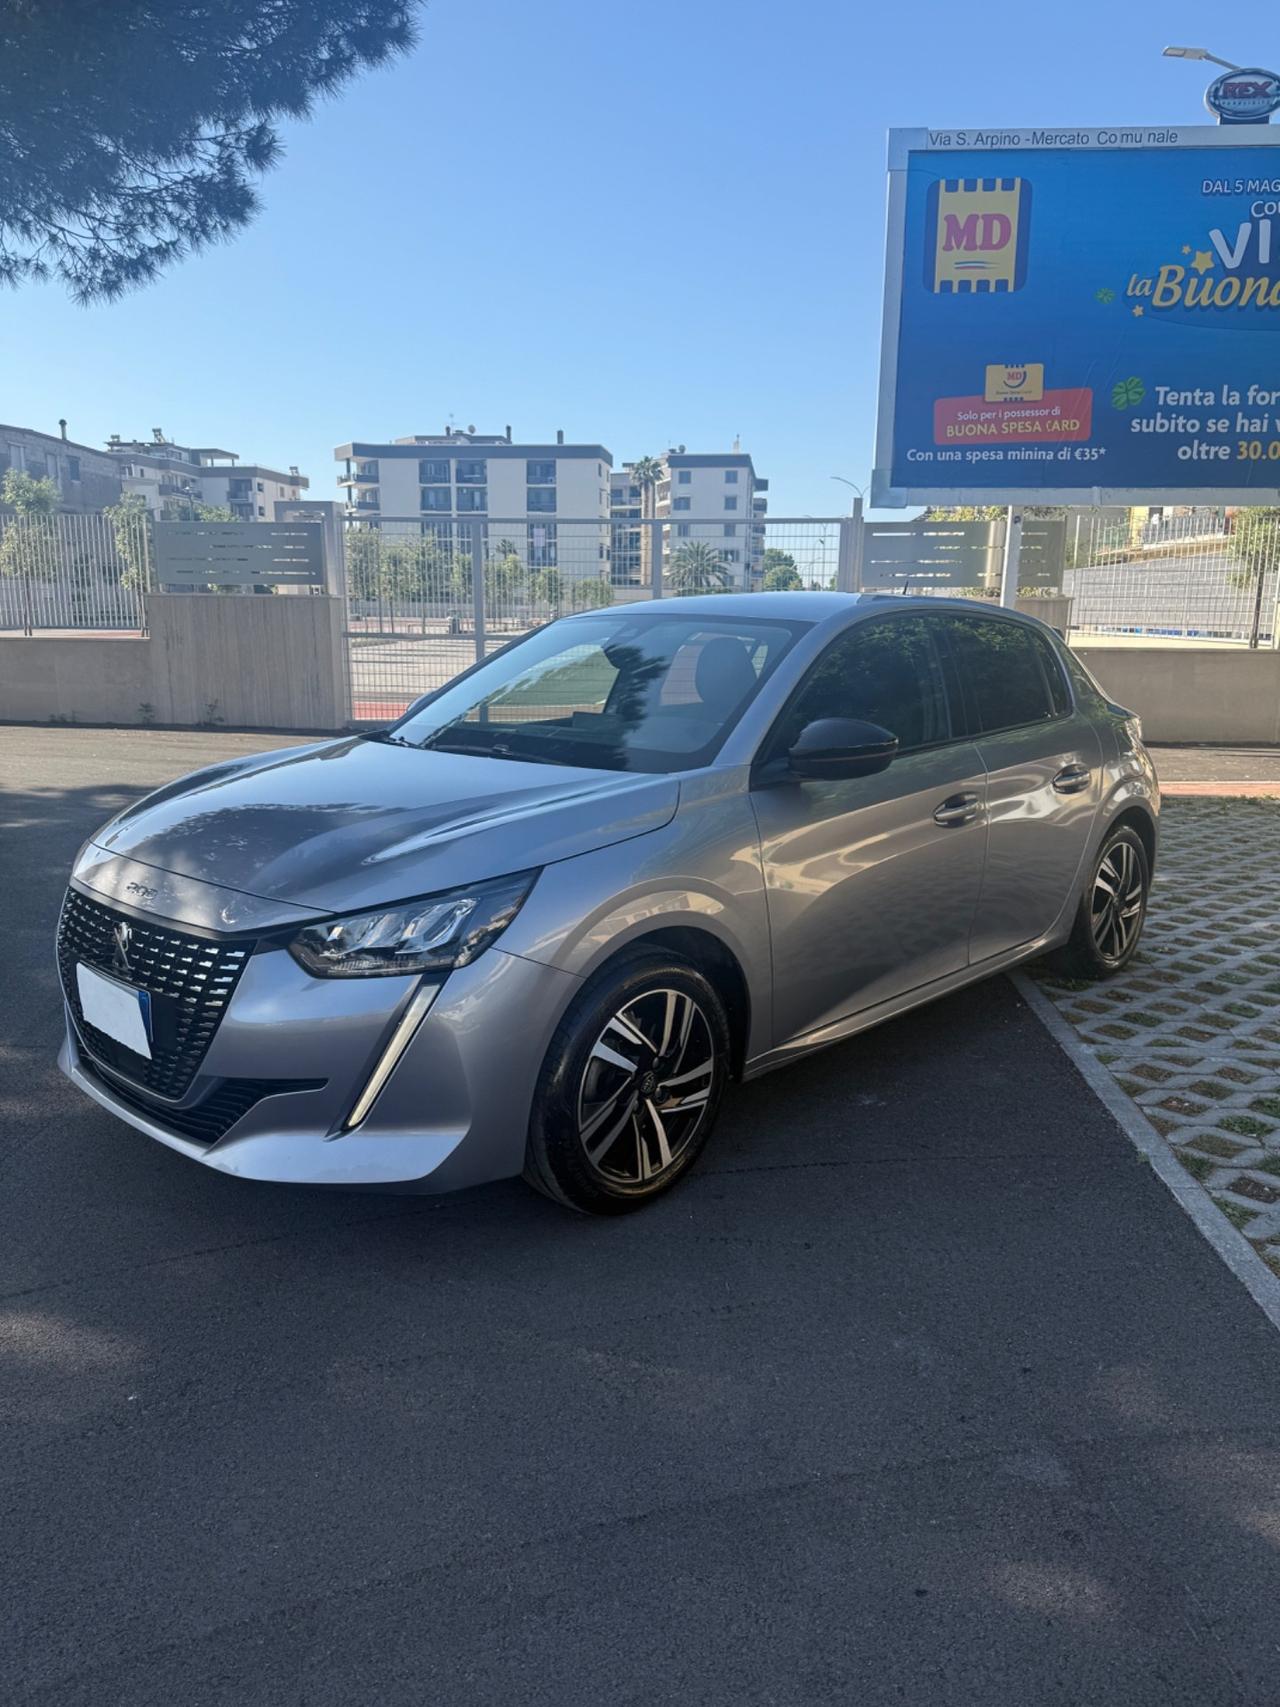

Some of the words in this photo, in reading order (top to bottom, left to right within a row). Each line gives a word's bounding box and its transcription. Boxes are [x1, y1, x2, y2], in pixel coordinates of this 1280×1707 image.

[1222, 81, 1274, 99] REX
[929, 132, 951, 146] Via
[956, 132, 970, 146] S.
[974, 132, 1021, 148] Arpino
[1202, 180, 1231, 194] DAL
[1234, 180, 1243, 193] 5
[942, 213, 1012, 252] MD
[1208, 219, 1271, 269] VI
[1126, 273, 1153, 297] la
[1007, 371, 1023, 381] MD
[1155, 386, 1215, 406] Tenta
[1222, 384, 1240, 406] la
[957, 410, 979, 421] Solo
[980, 410, 996, 422] per
[1051, 406, 1061, 416] di
[1130, 412, 1200, 433] subito
[1206, 418, 1230, 433] se
[1235, 411, 1269, 433] hai
[946, 423, 998, 437] BUONA
[1001, 421, 1042, 434] SPESA
[906, 449, 934, 461] Con
[937, 450, 962, 461] una
[965, 450, 1004, 464] spesa
[1057, 446, 1071, 460] di
[1177, 439, 1231, 460] oltre
